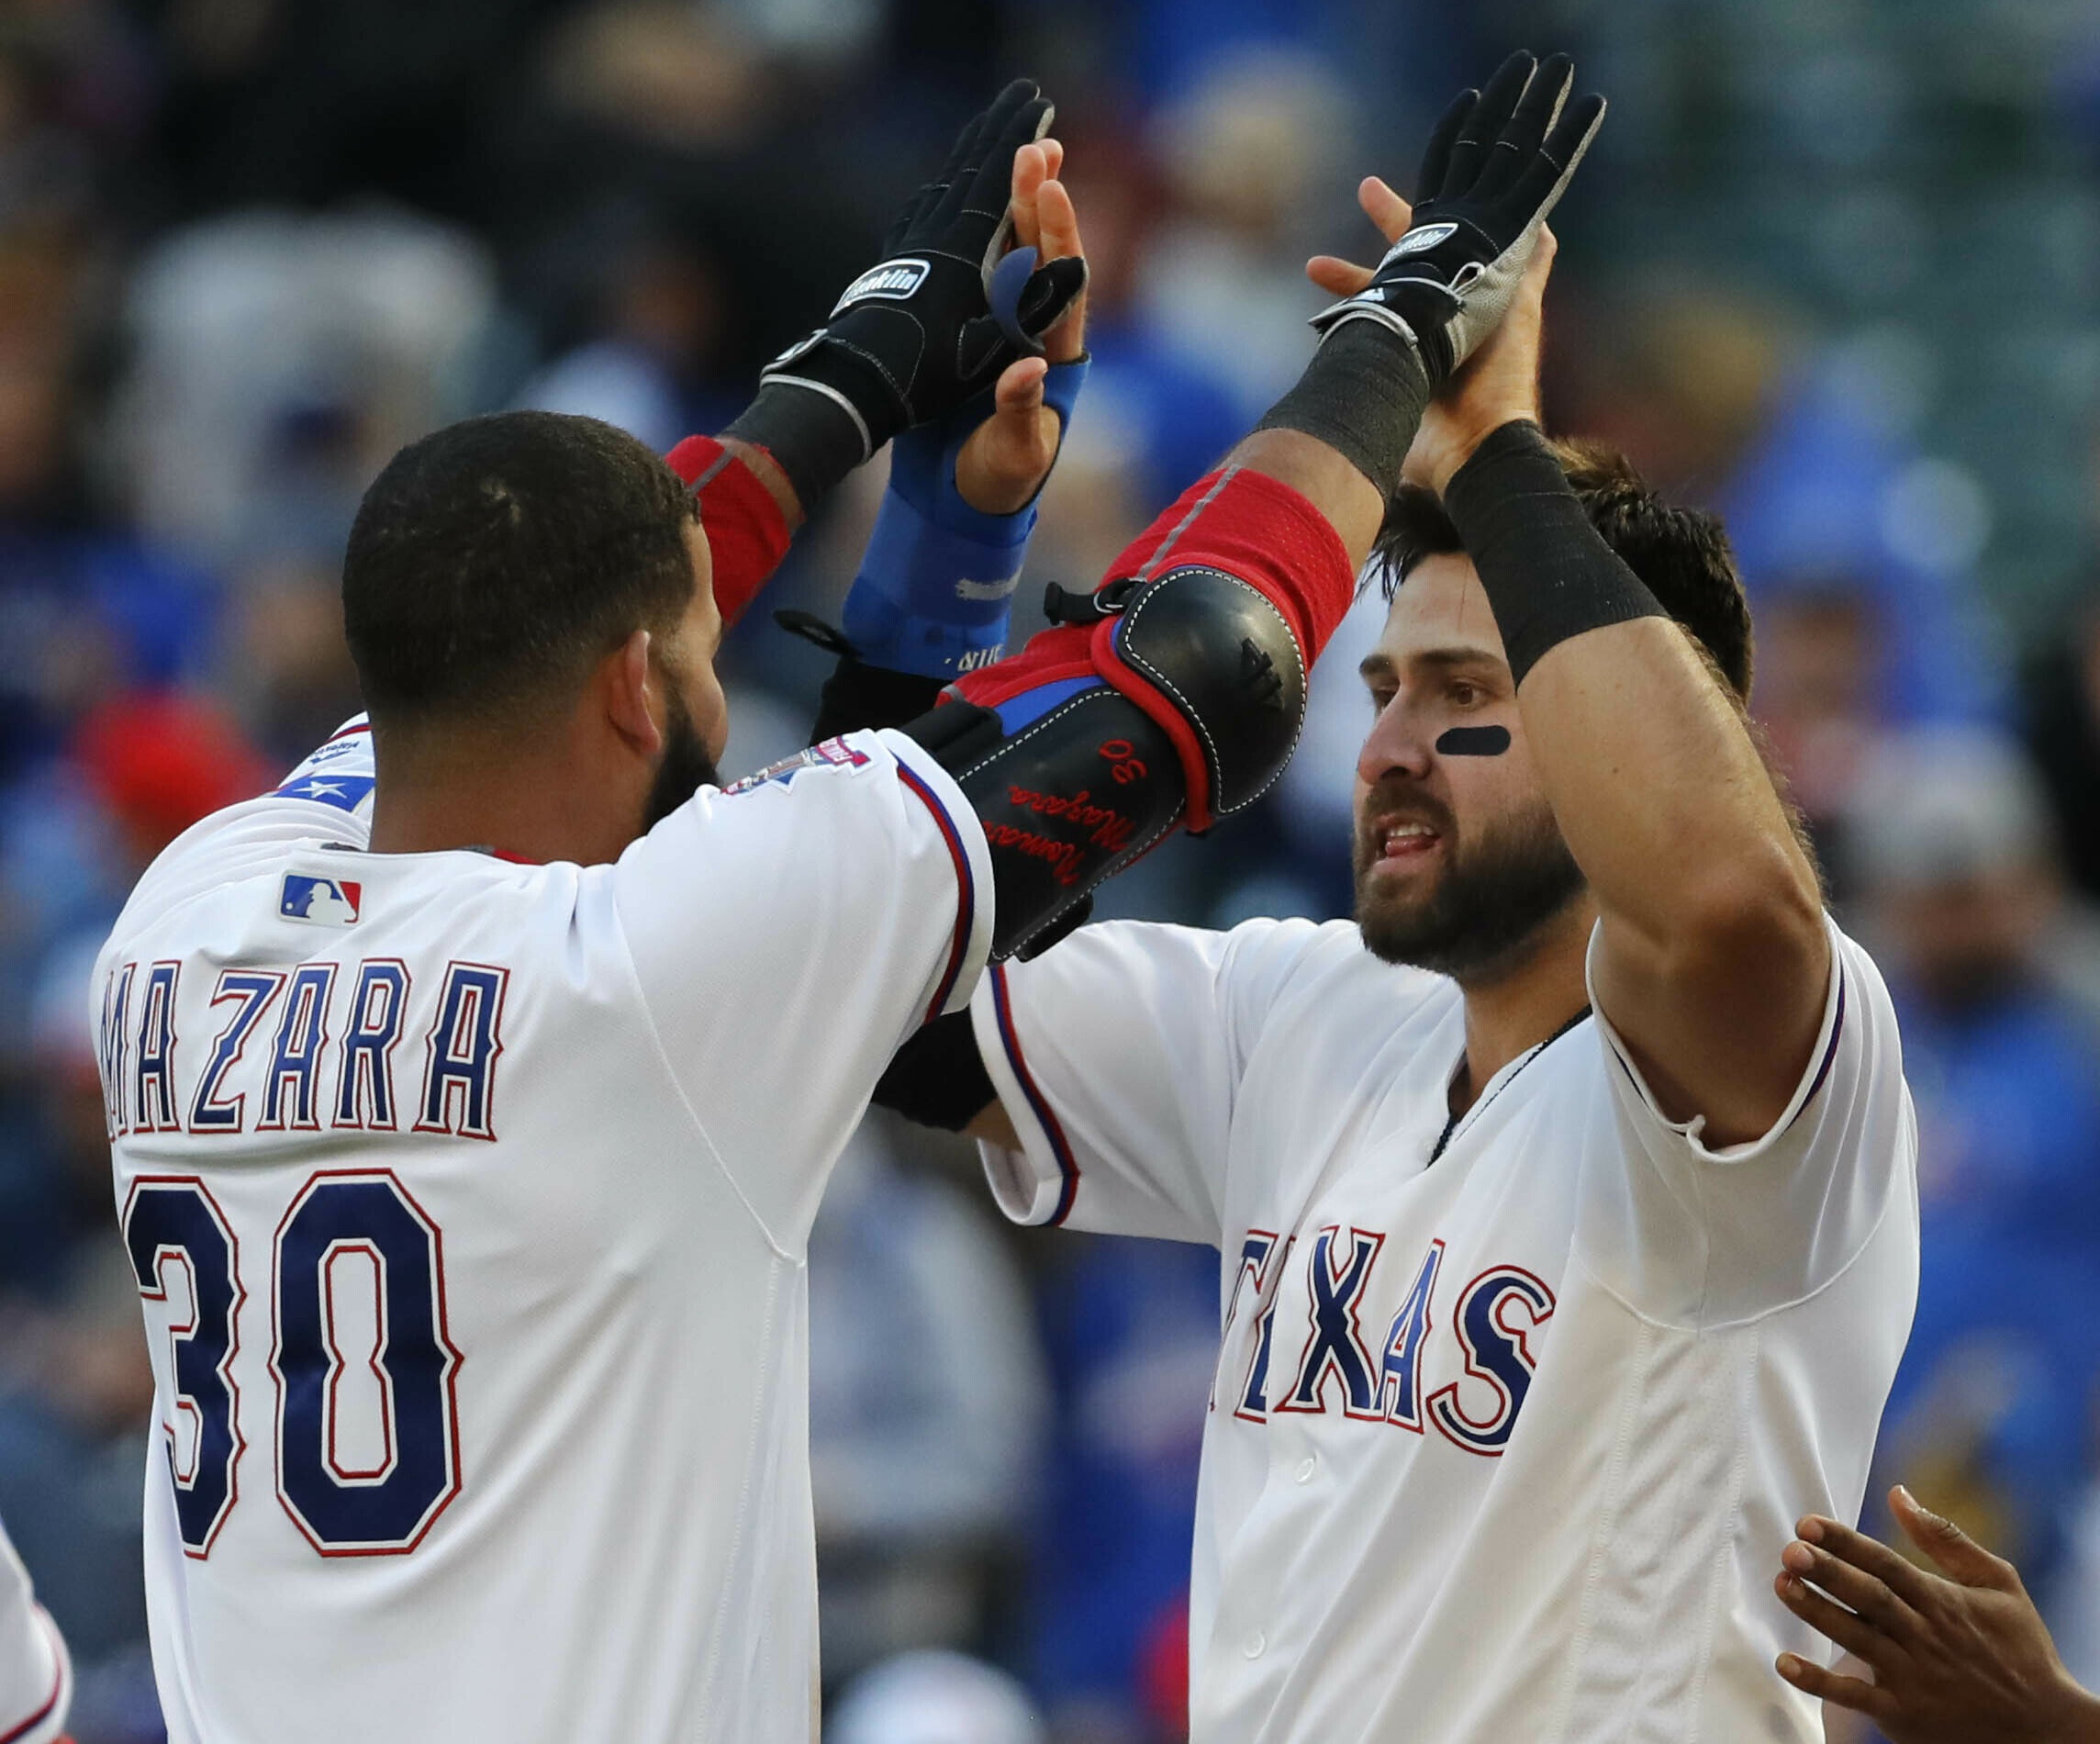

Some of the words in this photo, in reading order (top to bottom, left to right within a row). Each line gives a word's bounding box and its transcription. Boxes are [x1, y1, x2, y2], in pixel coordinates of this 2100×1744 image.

[957, 643, 1005, 673] NIK
[1098, 738, 1147, 784] 30
[983, 819, 1087, 886] Nomar
[1007, 784, 1135, 853] Mazara
[100, 957, 510, 1143] MAZARA
[122, 1168, 464, 1560] 30
